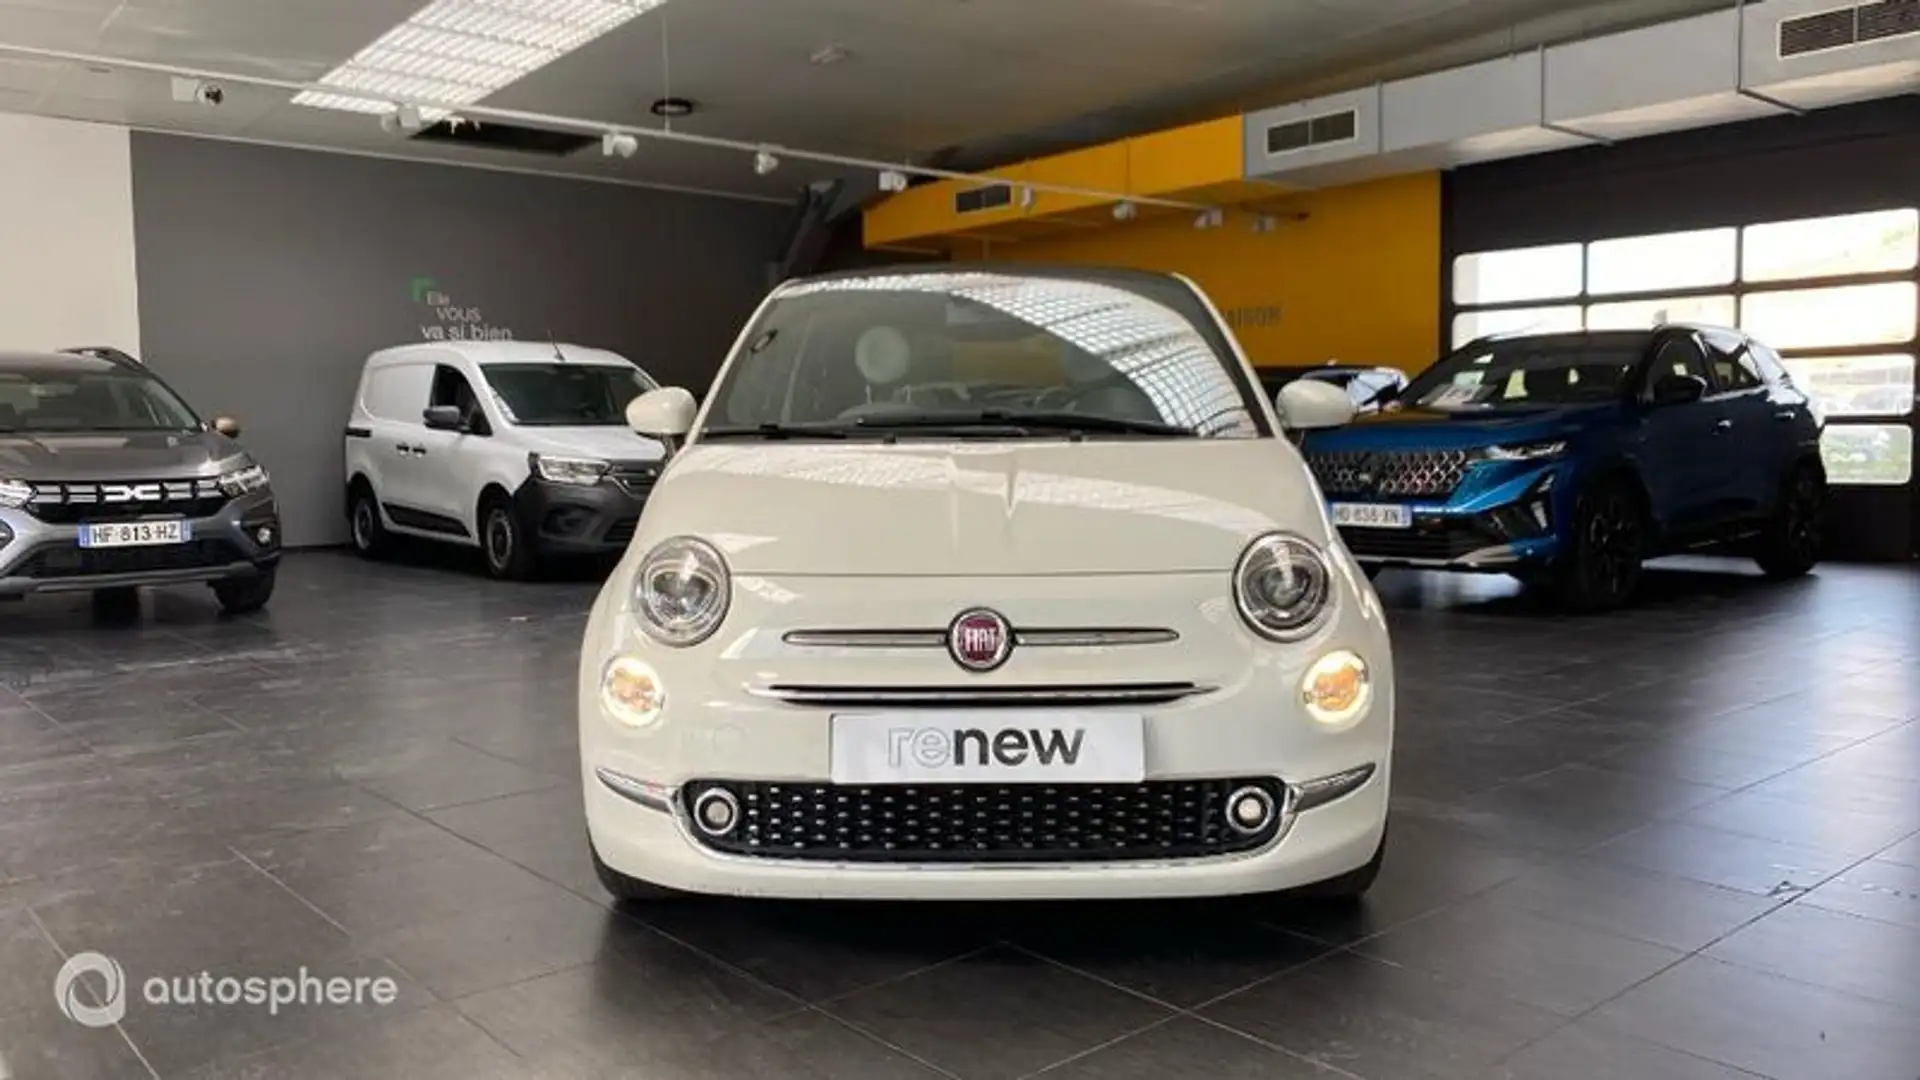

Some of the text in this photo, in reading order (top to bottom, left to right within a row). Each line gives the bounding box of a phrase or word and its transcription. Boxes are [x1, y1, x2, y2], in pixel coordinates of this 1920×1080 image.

[420, 323, 514, 342] va si bien
[963, 627, 997, 652] FIAT
[887, 726, 1086, 768] renew
